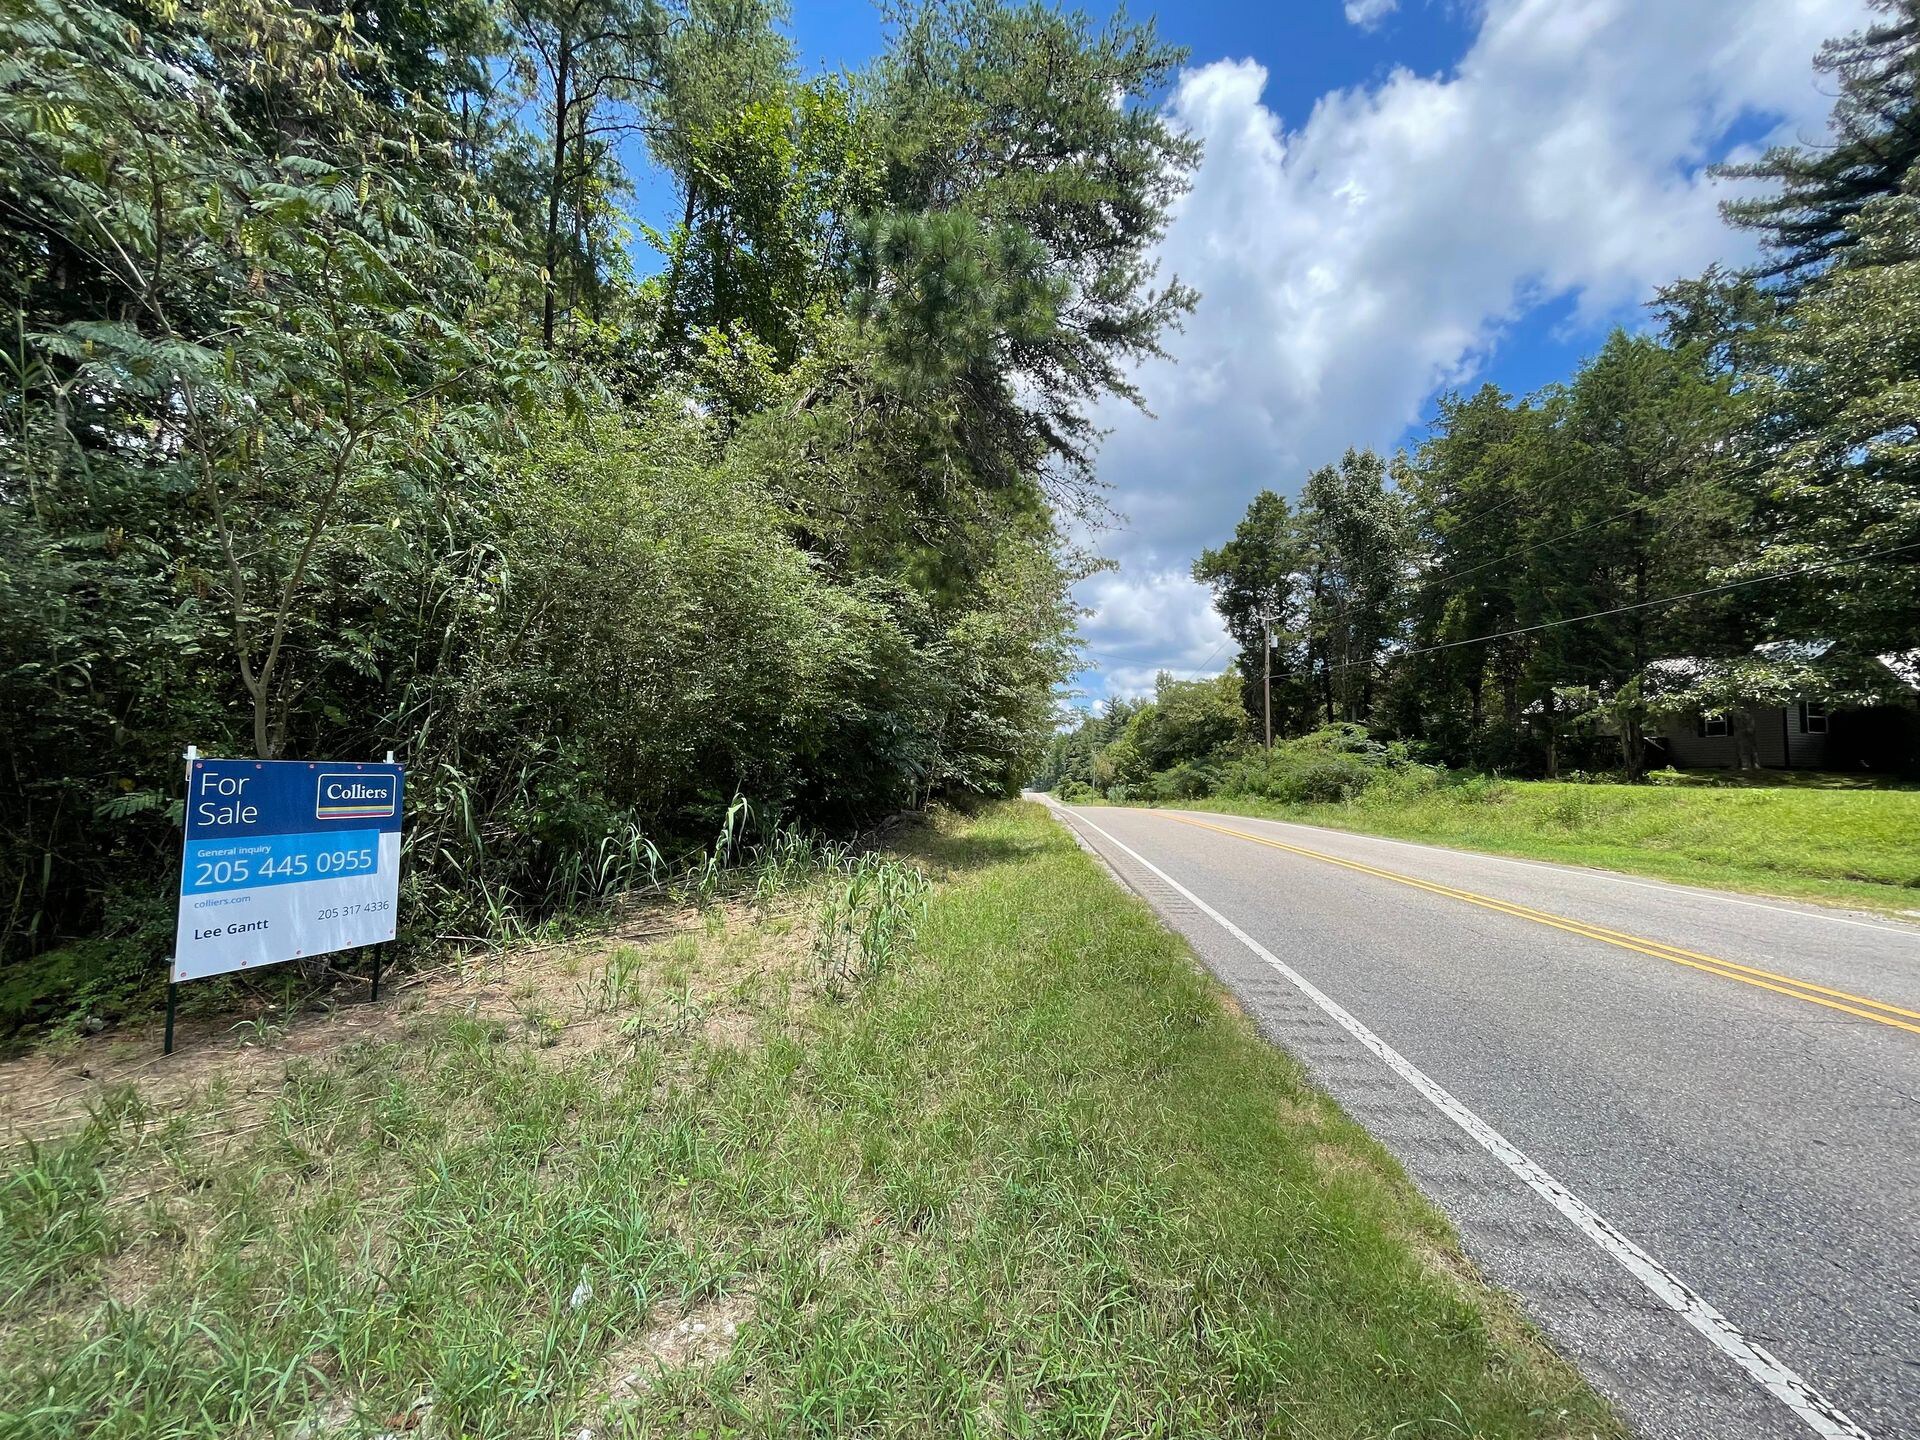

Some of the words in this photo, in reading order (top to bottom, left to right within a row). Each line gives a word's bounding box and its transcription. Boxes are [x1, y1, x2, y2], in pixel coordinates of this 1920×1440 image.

[201, 772, 250, 796] For
[327, 784, 387, 800] Colliers
[197, 801, 258, 826] Sale
[197, 847, 237, 858] General
[239, 845, 271, 856] inquiry
[195, 859, 249, 886] 205
[258, 855, 308, 879] 445
[316, 849, 371, 873] 0955
[194, 895, 251, 909] colliers.com
[317, 908, 339, 921] 205
[342, 904, 361, 918] 317
[364, 900, 389, 914] 4336
[194, 926, 222, 940] Lee
[227, 919, 269, 935] Gantt
